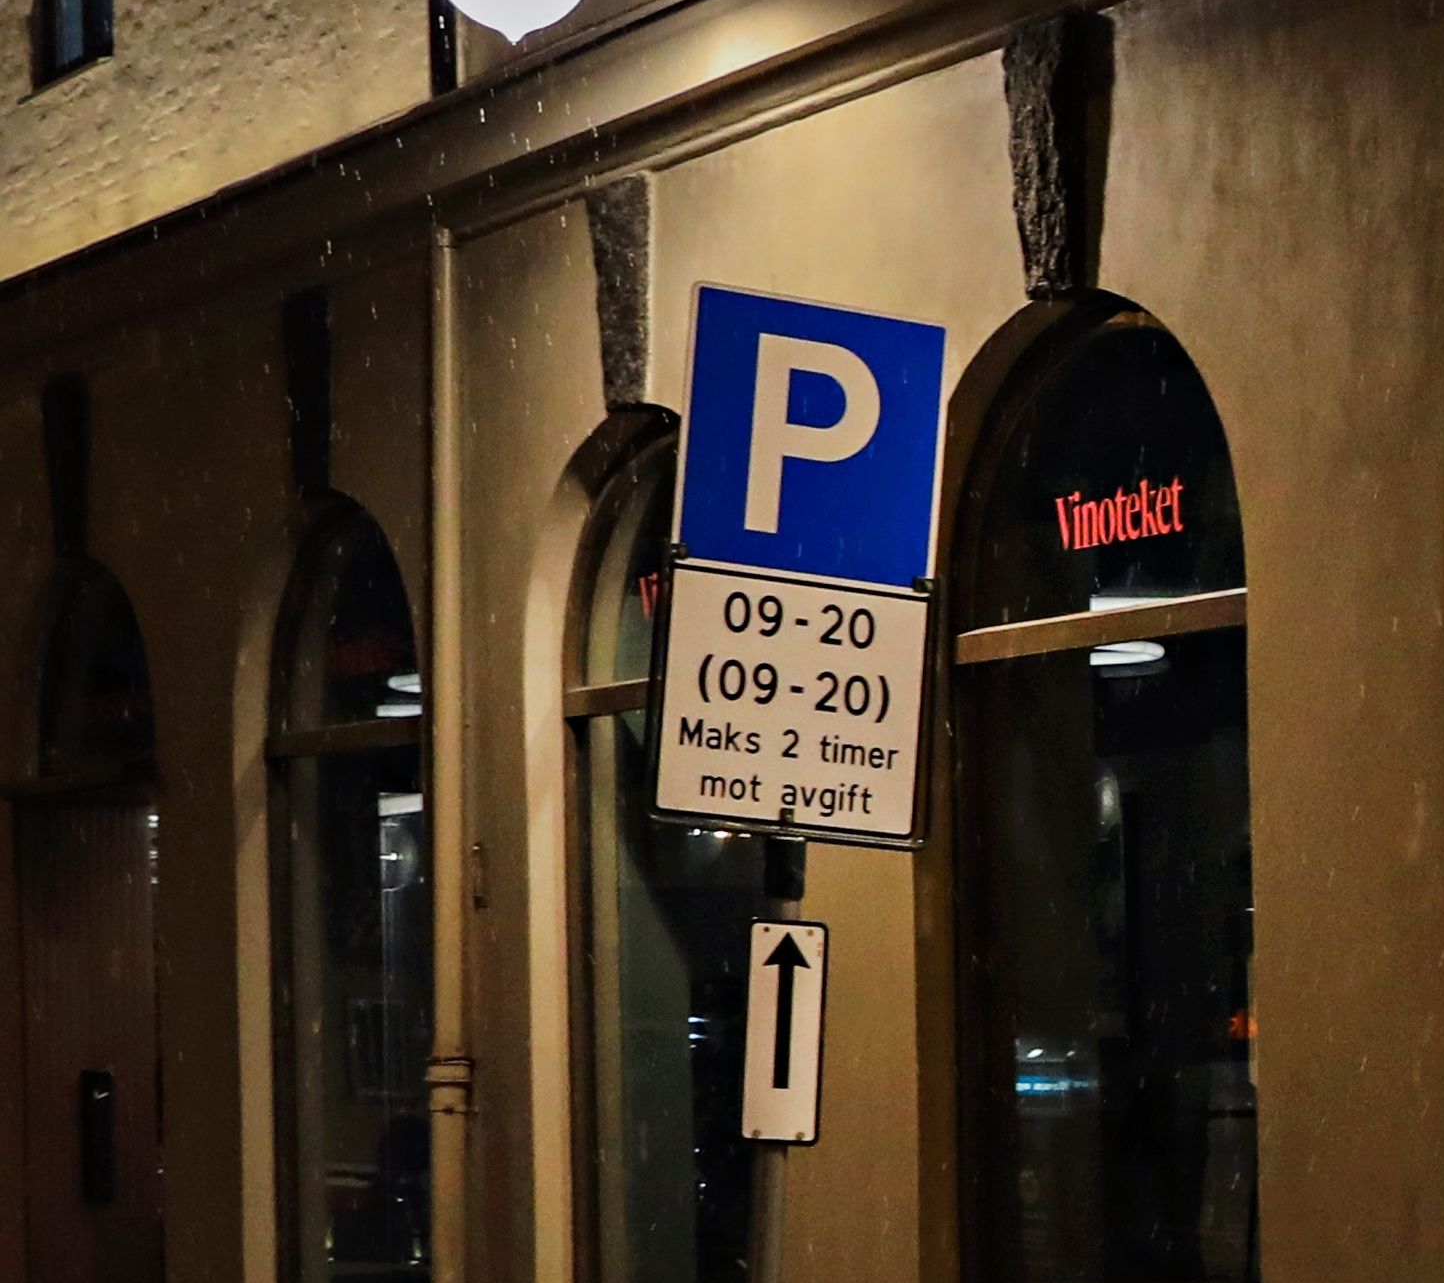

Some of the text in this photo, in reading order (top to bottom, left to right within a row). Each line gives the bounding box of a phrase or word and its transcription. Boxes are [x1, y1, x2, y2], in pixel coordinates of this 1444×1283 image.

[744, 332, 881, 534] P
[1055, 476, 1183, 550] Vinoteket
[724, 591, 876, 649] 09-20
[698, 654, 890, 723] (09-20)
[679, 717, 898, 770] Maks 2 timer
[700, 775, 872, 817] mot avgift
